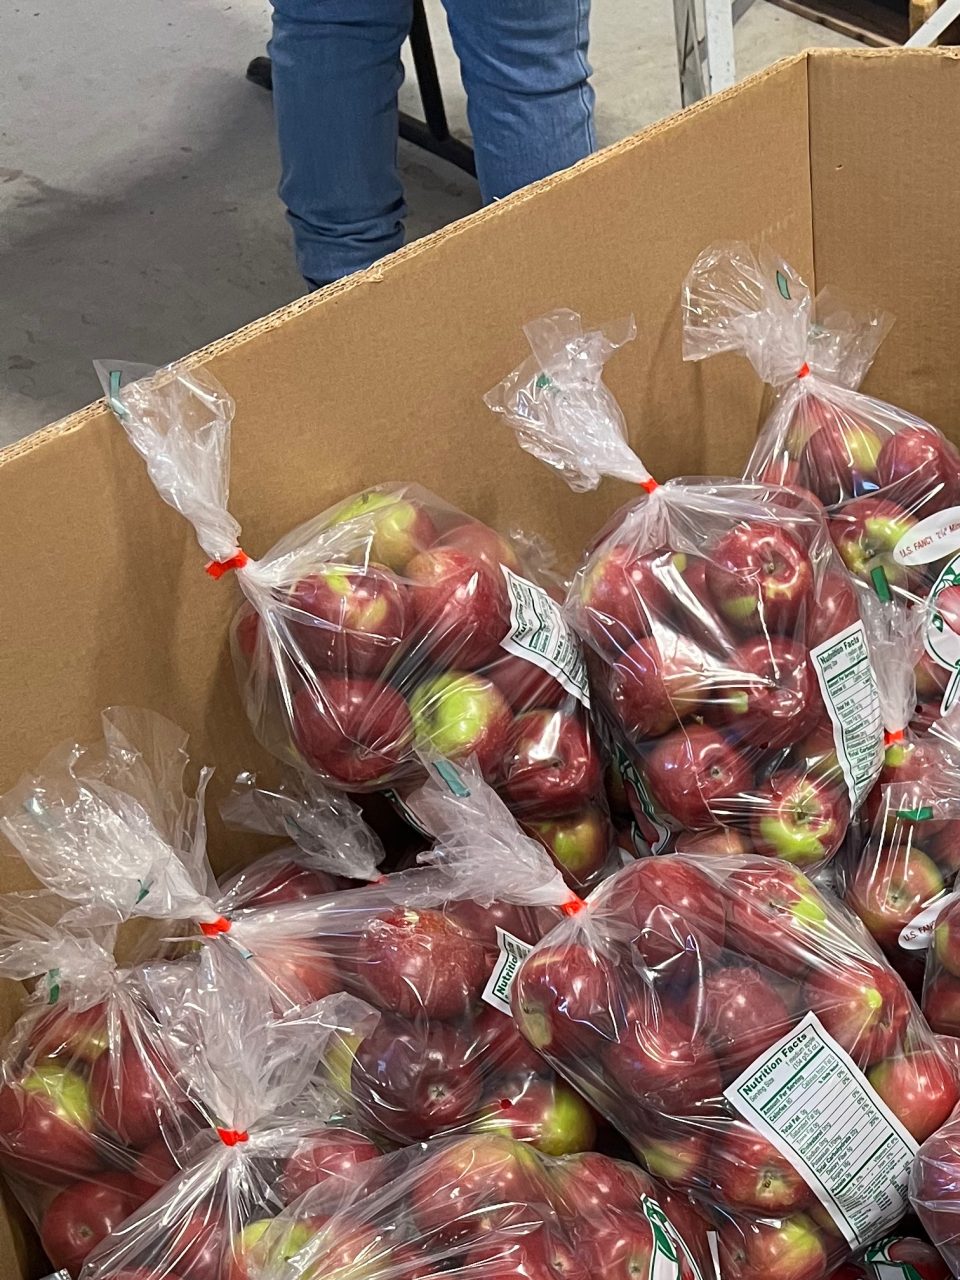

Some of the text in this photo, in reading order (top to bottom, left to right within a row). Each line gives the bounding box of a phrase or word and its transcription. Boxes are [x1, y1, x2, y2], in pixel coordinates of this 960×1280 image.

[914, 535, 933, 551] FANCY
[742, 1031, 807, 1095] Nutrition Facts
